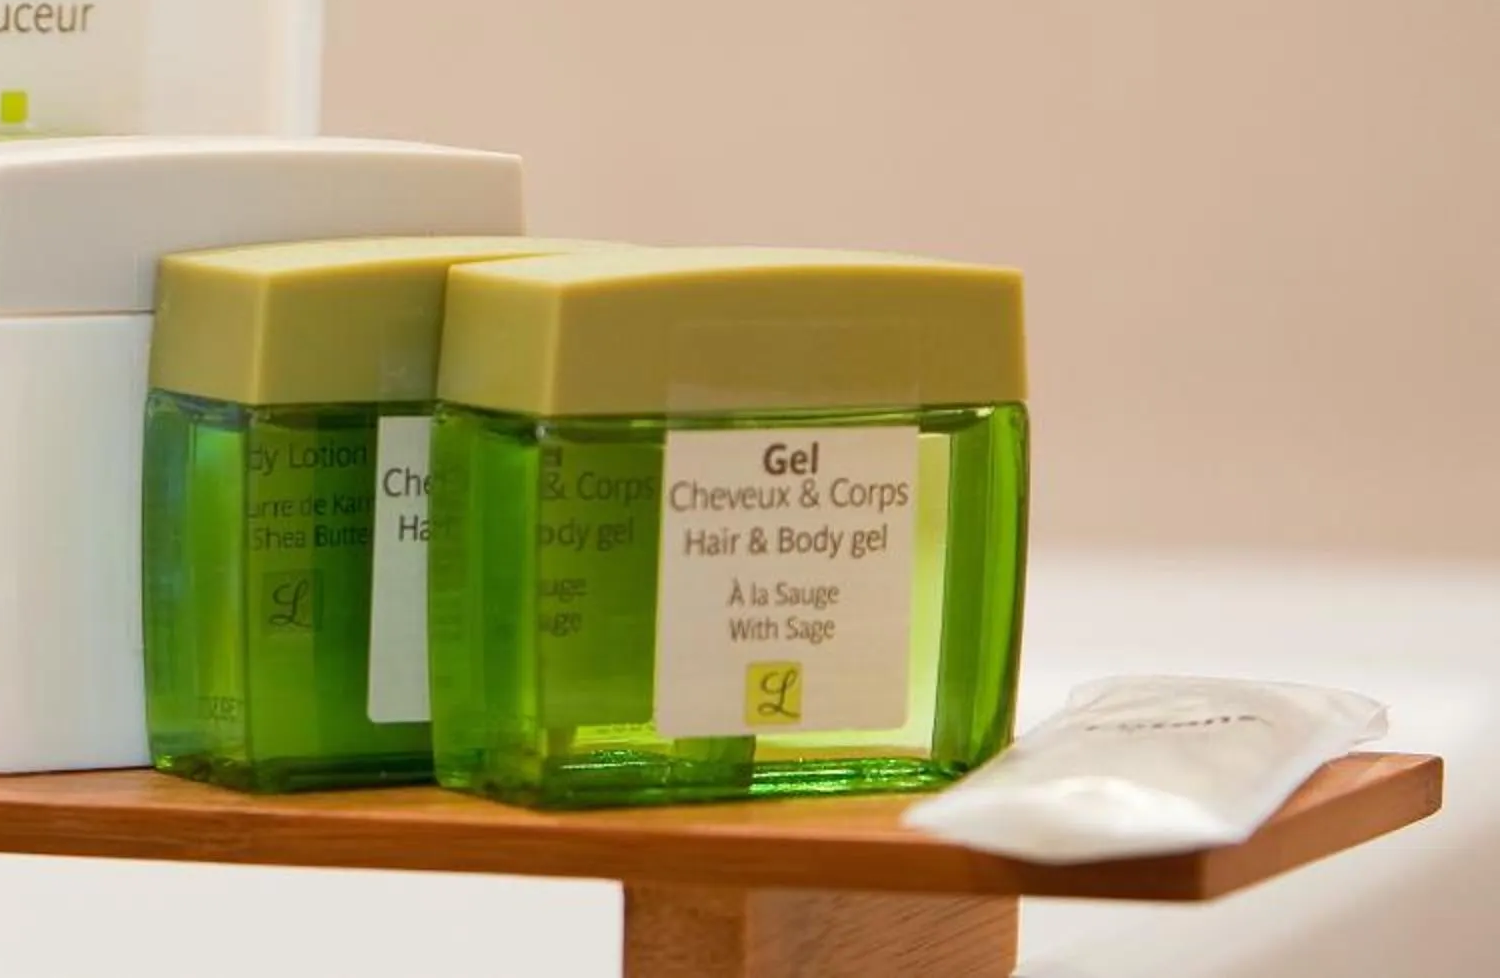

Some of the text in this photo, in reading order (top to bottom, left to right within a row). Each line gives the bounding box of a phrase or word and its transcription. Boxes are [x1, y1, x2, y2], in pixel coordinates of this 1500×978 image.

[287, 439, 368, 468] Lotion
[762, 441, 819, 476] Gel
[577, 471, 656, 507] Corps
[669, 477, 910, 513] Cheveux & Corps
[251, 526, 306, 551] Shea
[597, 518, 634, 552] gel
[684, 523, 888, 559] Hair & Body gel
[752, 582, 769, 606] la
[775, 581, 840, 610] Sauge
[729, 616, 836, 645] With Sage
